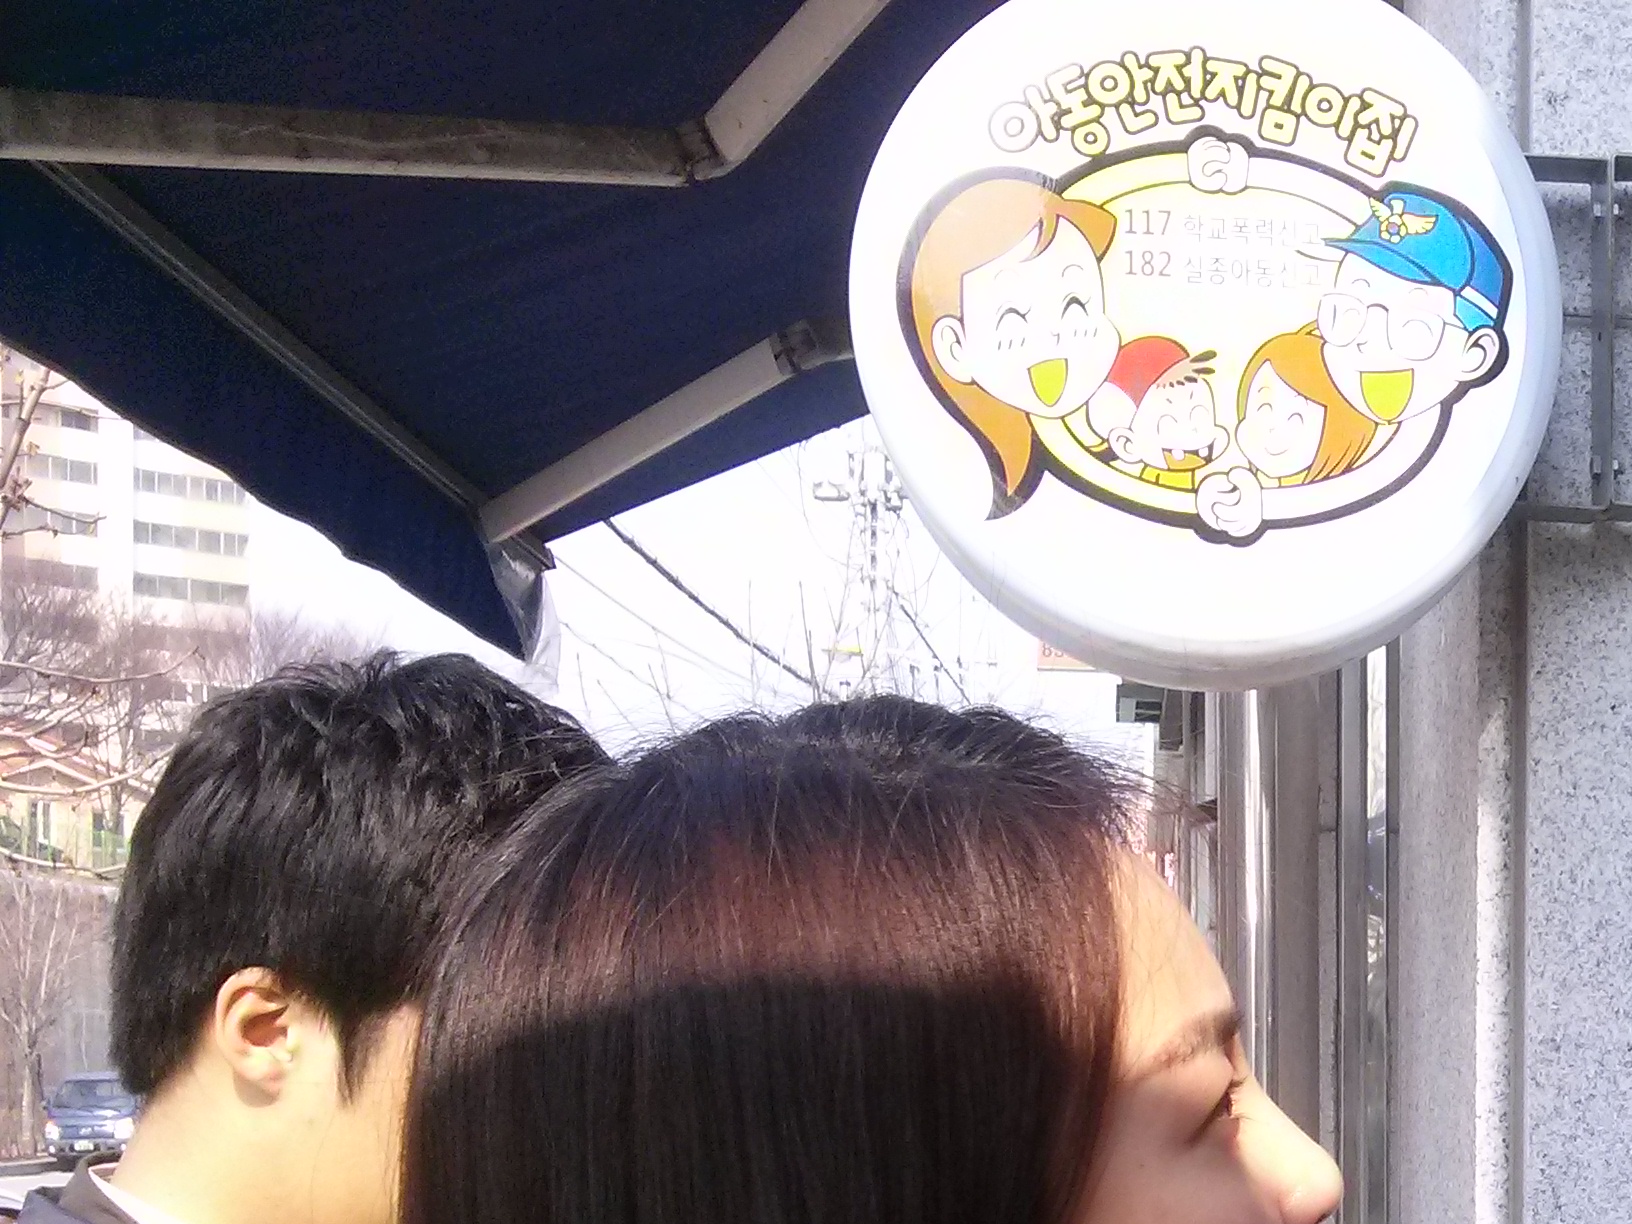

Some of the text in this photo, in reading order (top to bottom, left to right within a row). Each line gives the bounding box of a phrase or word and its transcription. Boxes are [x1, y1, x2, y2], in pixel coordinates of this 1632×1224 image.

[988, 45, 1419, 177] 아동안전지킴이집
[1124, 208, 1321, 247] 117 학교폭력신고
[1124, 250, 1321, 288] 182 실종아동신고
